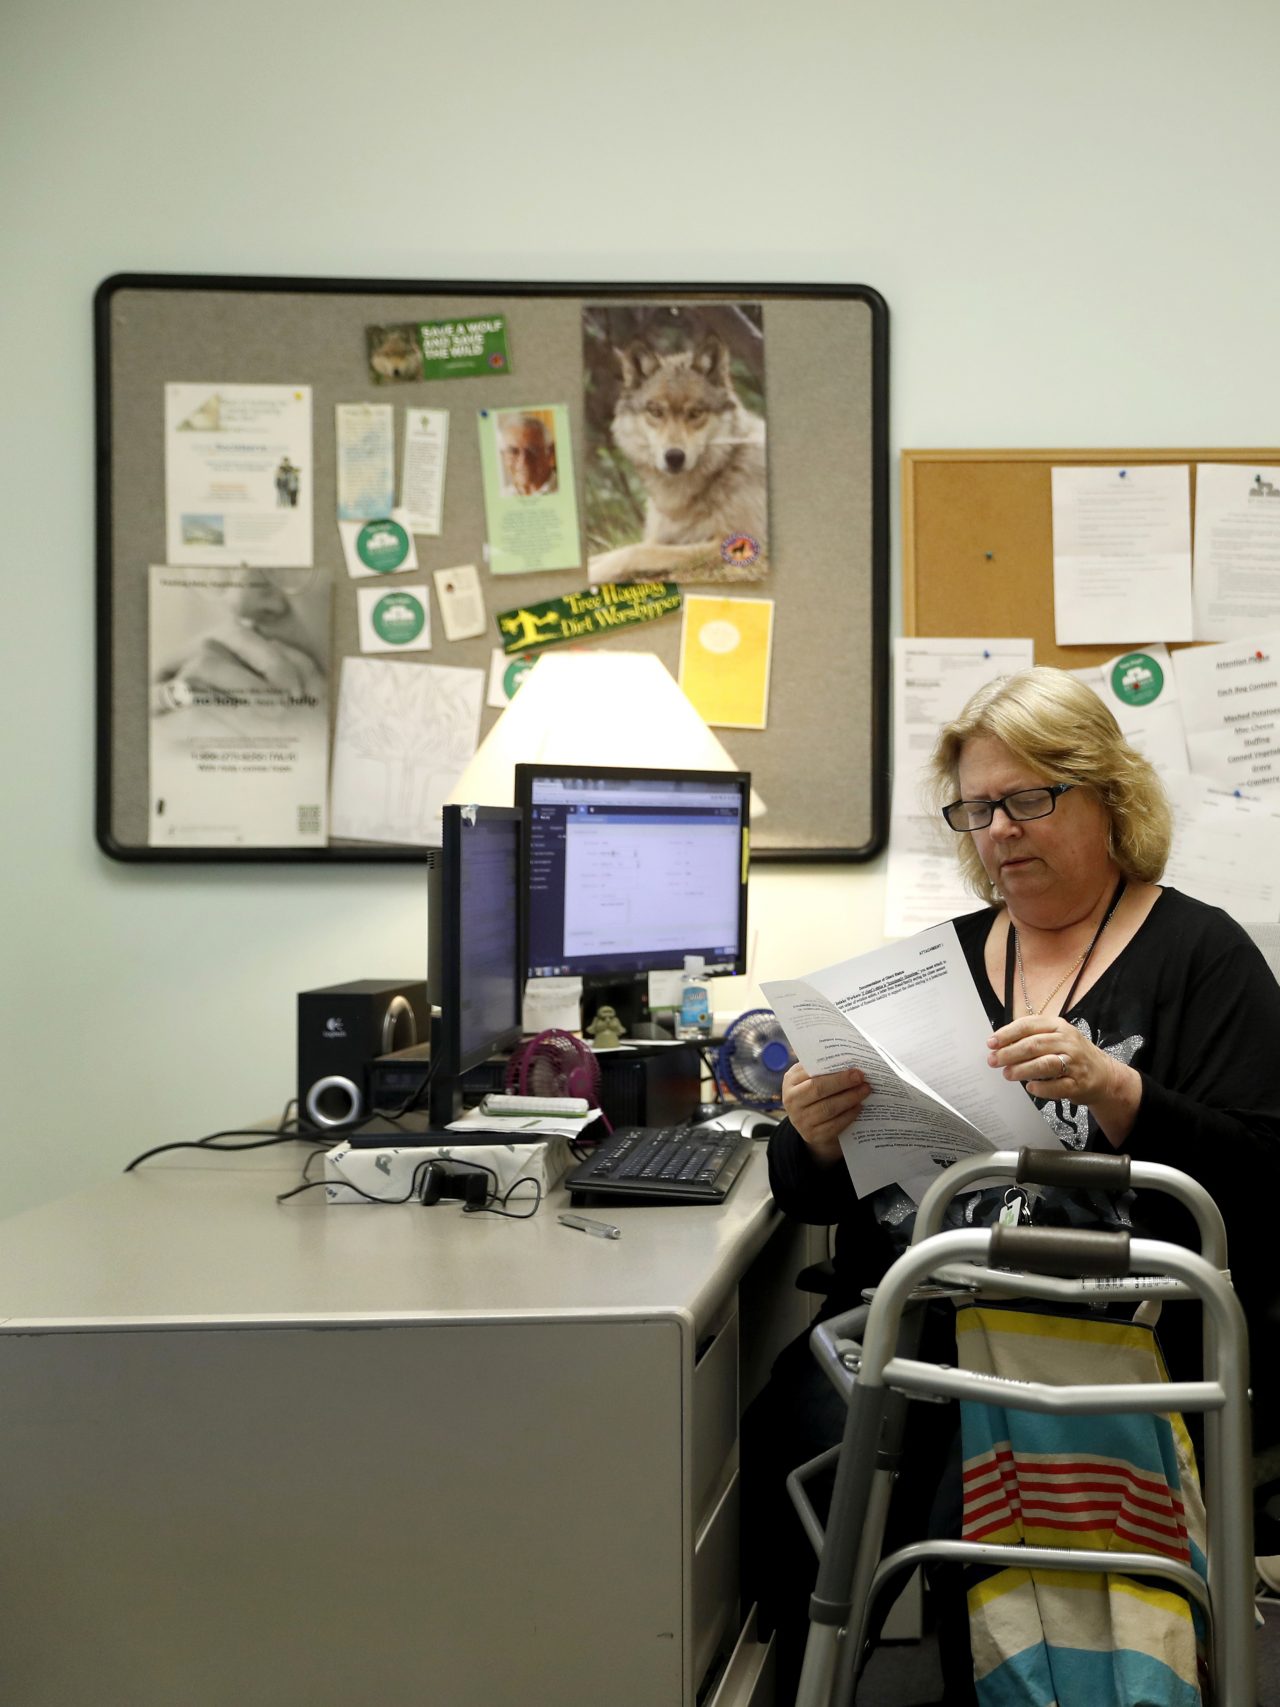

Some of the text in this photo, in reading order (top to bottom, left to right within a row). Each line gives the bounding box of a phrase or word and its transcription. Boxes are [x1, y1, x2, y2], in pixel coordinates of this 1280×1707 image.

[421, 319, 503, 338] SAVE A WOLF
[423, 333, 485, 350] AND SAVE
[425, 344, 484, 360] THE WILD
[562, 583, 667, 614] Tree Hugging
[561, 594, 682, 638] Dirt Worshipper
[1216, 658, 1247, 671] Attention
[1249, 680, 1278, 693] Contains
[1224, 707, 1280, 723] Mashed Potatoes
[1250, 722, 1275, 733] Cheese
[1244, 736, 1271, 748] Stuffing
[1227, 753, 1253, 764] Canned
[1246, 775, 1280, 788] Cranberry
